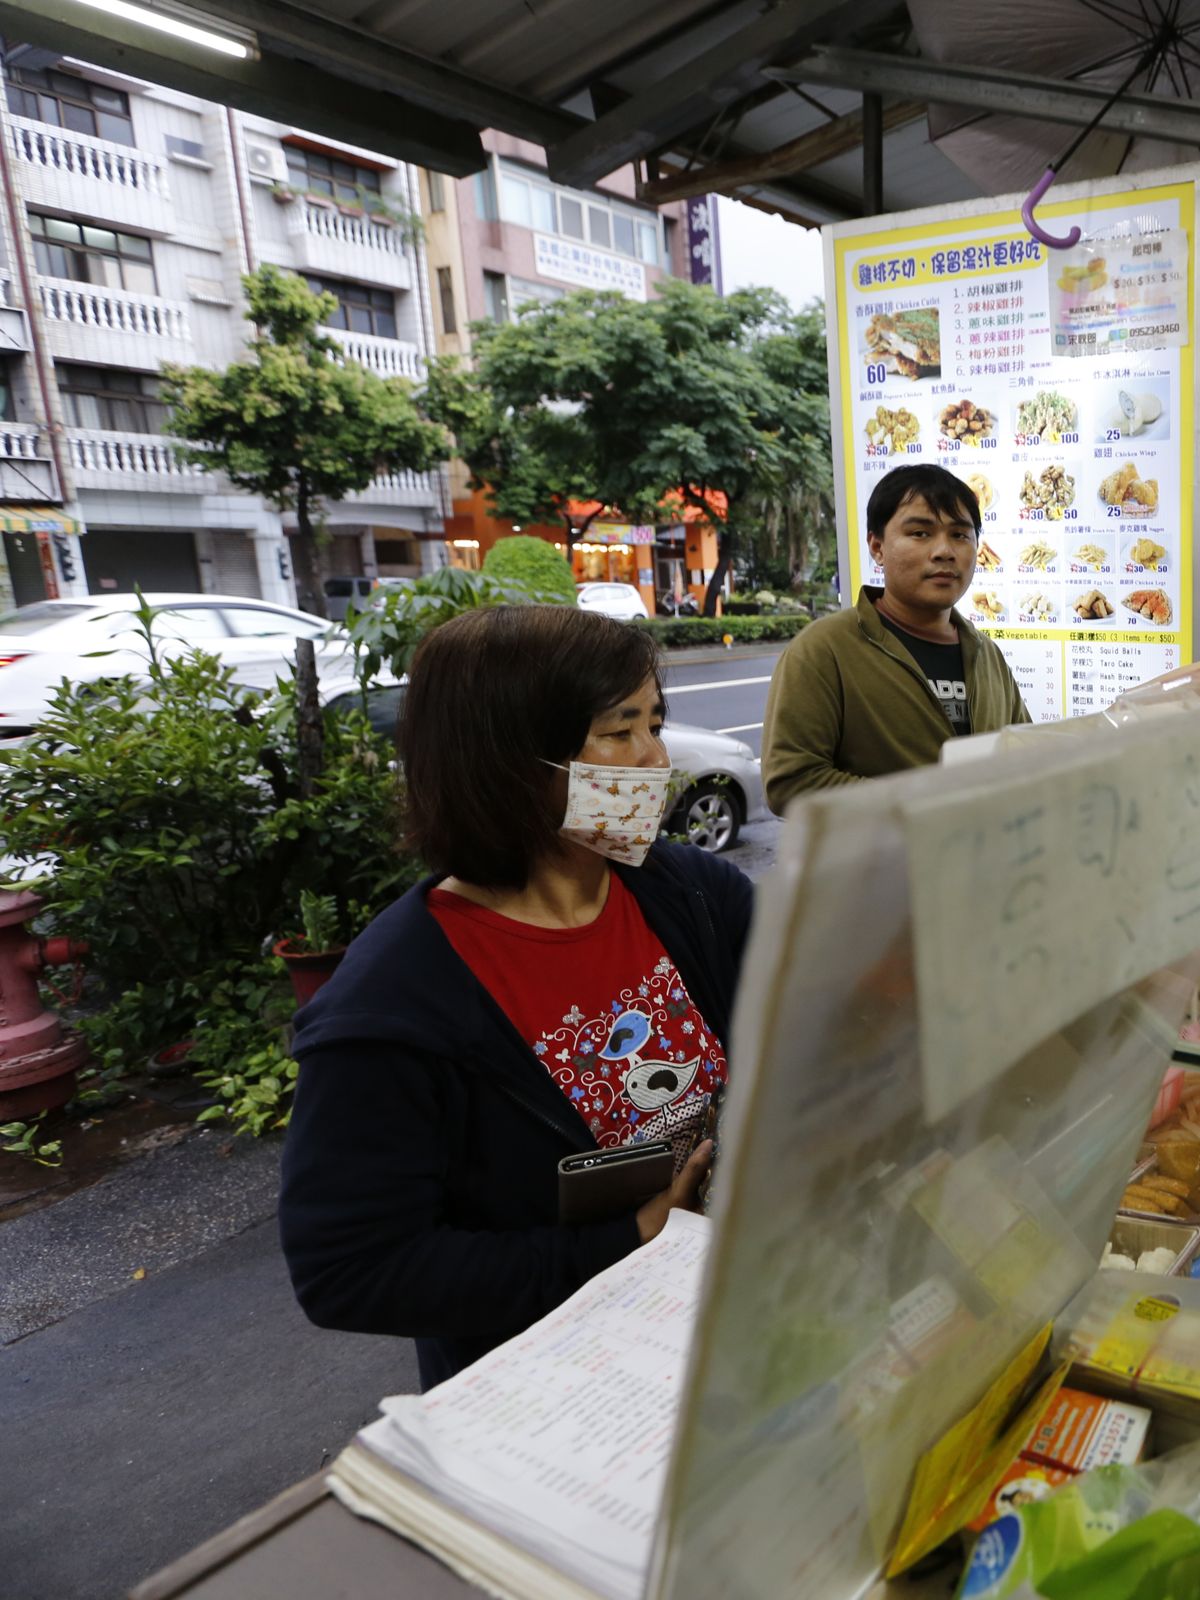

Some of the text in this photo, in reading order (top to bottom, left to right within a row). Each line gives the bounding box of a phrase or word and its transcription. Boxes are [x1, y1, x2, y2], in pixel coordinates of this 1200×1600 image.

[867, 364, 886, 384] 60
[1061, 433, 1079, 444] 100
[1106, 429, 1121, 441] 25
[948, 441, 961, 451] 50
[980, 438, 997, 450] 100
[1026, 436, 1040, 446] 50
[876, 446, 889, 456] 50
[906, 443, 922, 454] 100
[1115, 450, 1138, 458] Chicken
[984, 511, 997, 522] 50
[1031, 510, 1043, 521] 30
[1064, 508, 1077, 520] 50
[1107, 506, 1121, 518] 25
[1128, 617, 1137, 625] 70
[1006, 631, 1048, 640] Vegetable
[1145, 634, 1155, 642] for
[1100, 646, 1119, 656] Squid
[1122, 647, 1141, 655] Balls
[1101, 659, 1115, 667] Taro
[1118, 660, 1134, 668] Cake
[1016, 665, 1036, 673] Pepper
[1100, 672, 1115, 680] Hash
[1118, 673, 1141, 682] Browns
[1046, 682, 1054, 690] 30
[1100, 685, 1115, 693] Rice
